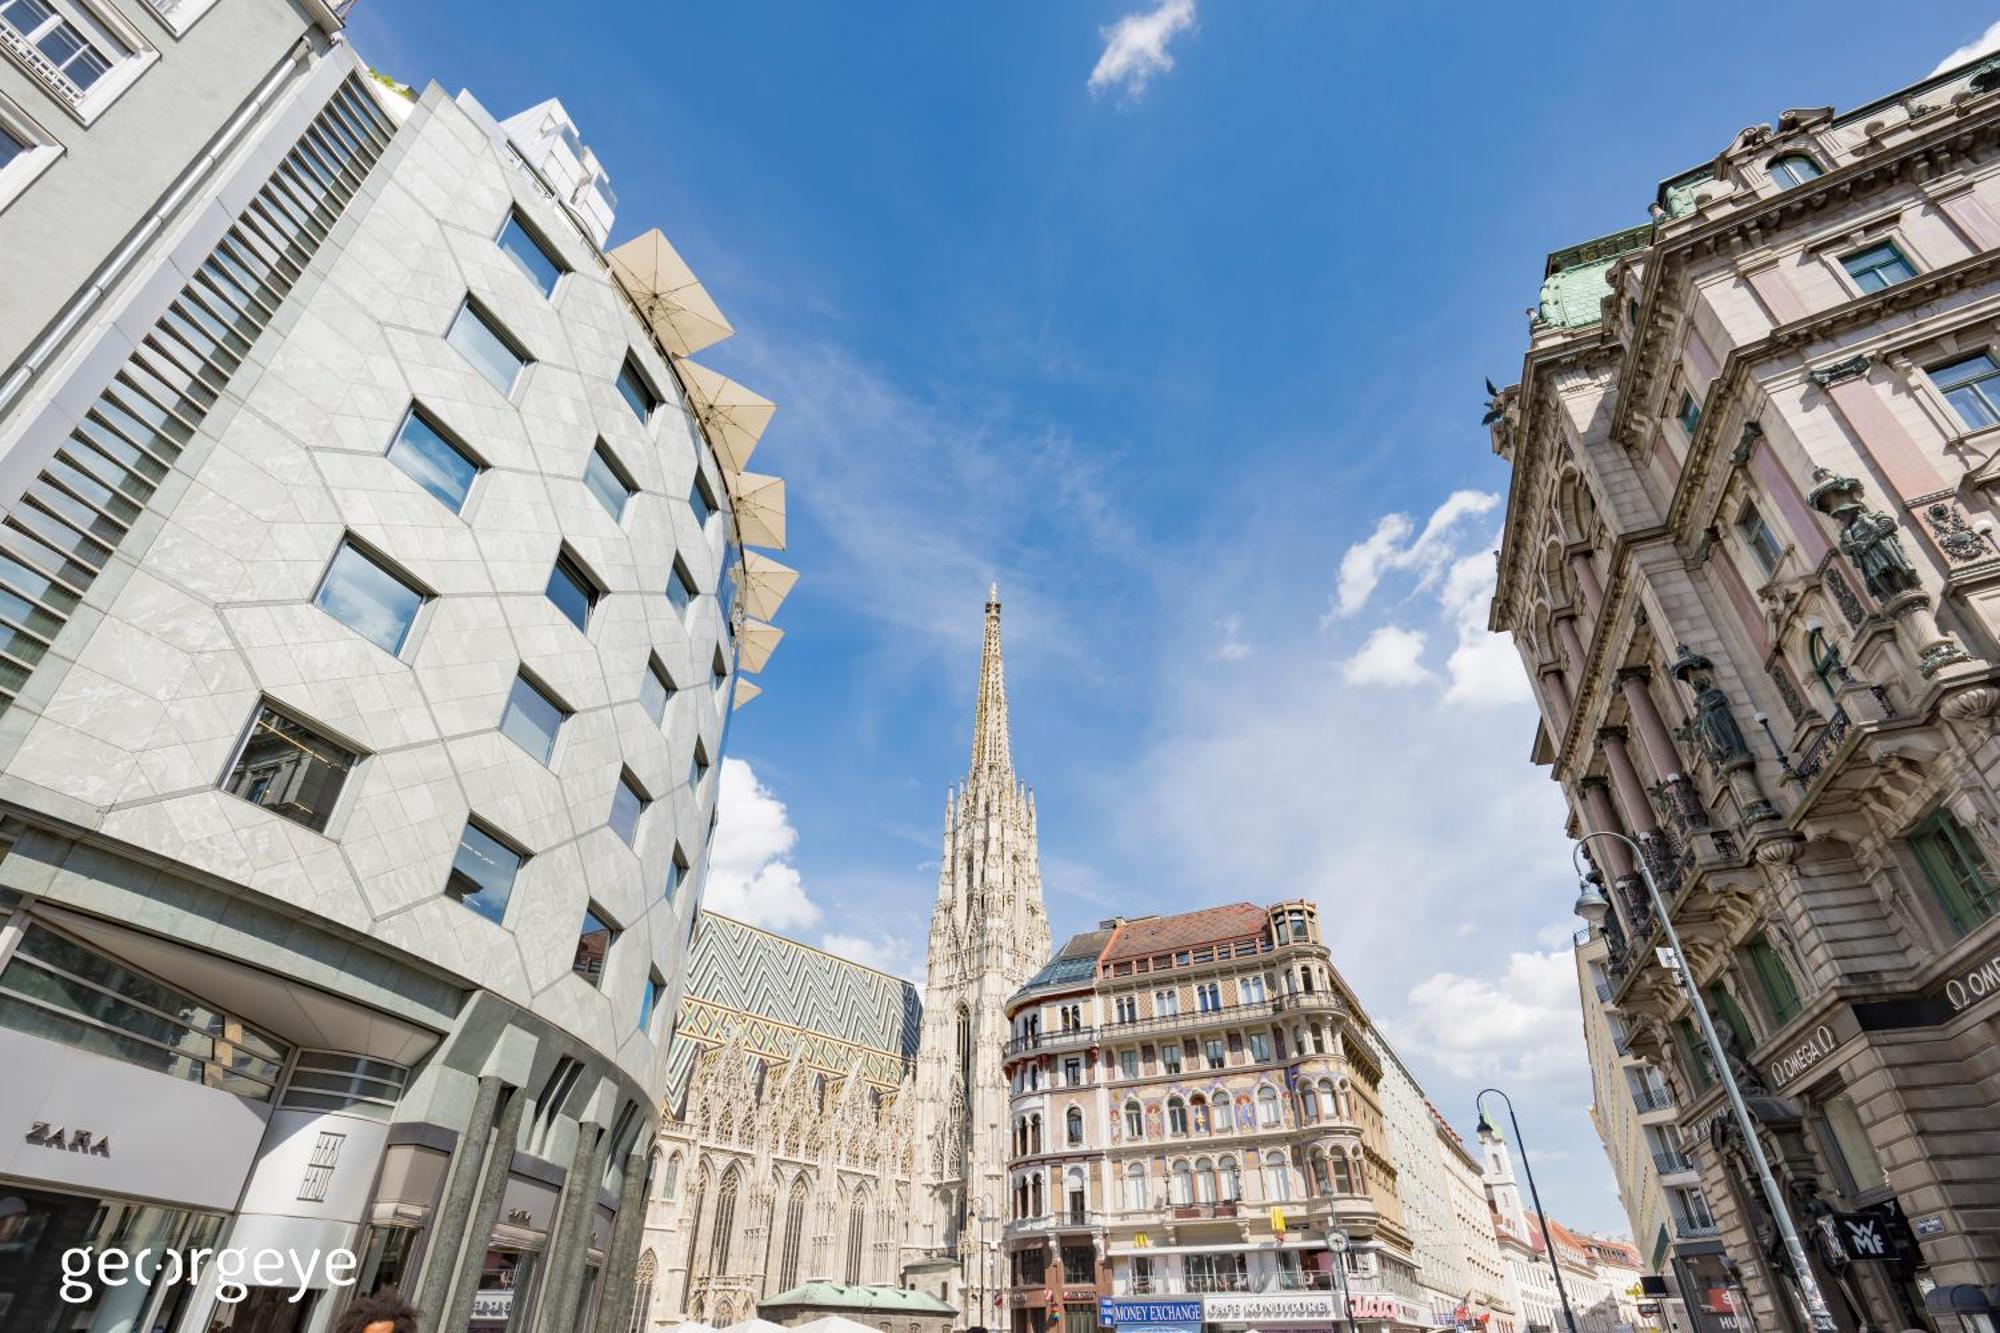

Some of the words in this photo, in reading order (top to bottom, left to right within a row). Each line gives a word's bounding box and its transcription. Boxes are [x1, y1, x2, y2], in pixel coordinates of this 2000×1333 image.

[1783, 1040, 1822, 1077] OMEGA
[24, 1121, 110, 1159] ZARA
[1844, 1220, 1884, 1255] WMF
[1115, 1305, 1148, 1321] MONEY
[1149, 1304, 1201, 1321] EXCHANGE
